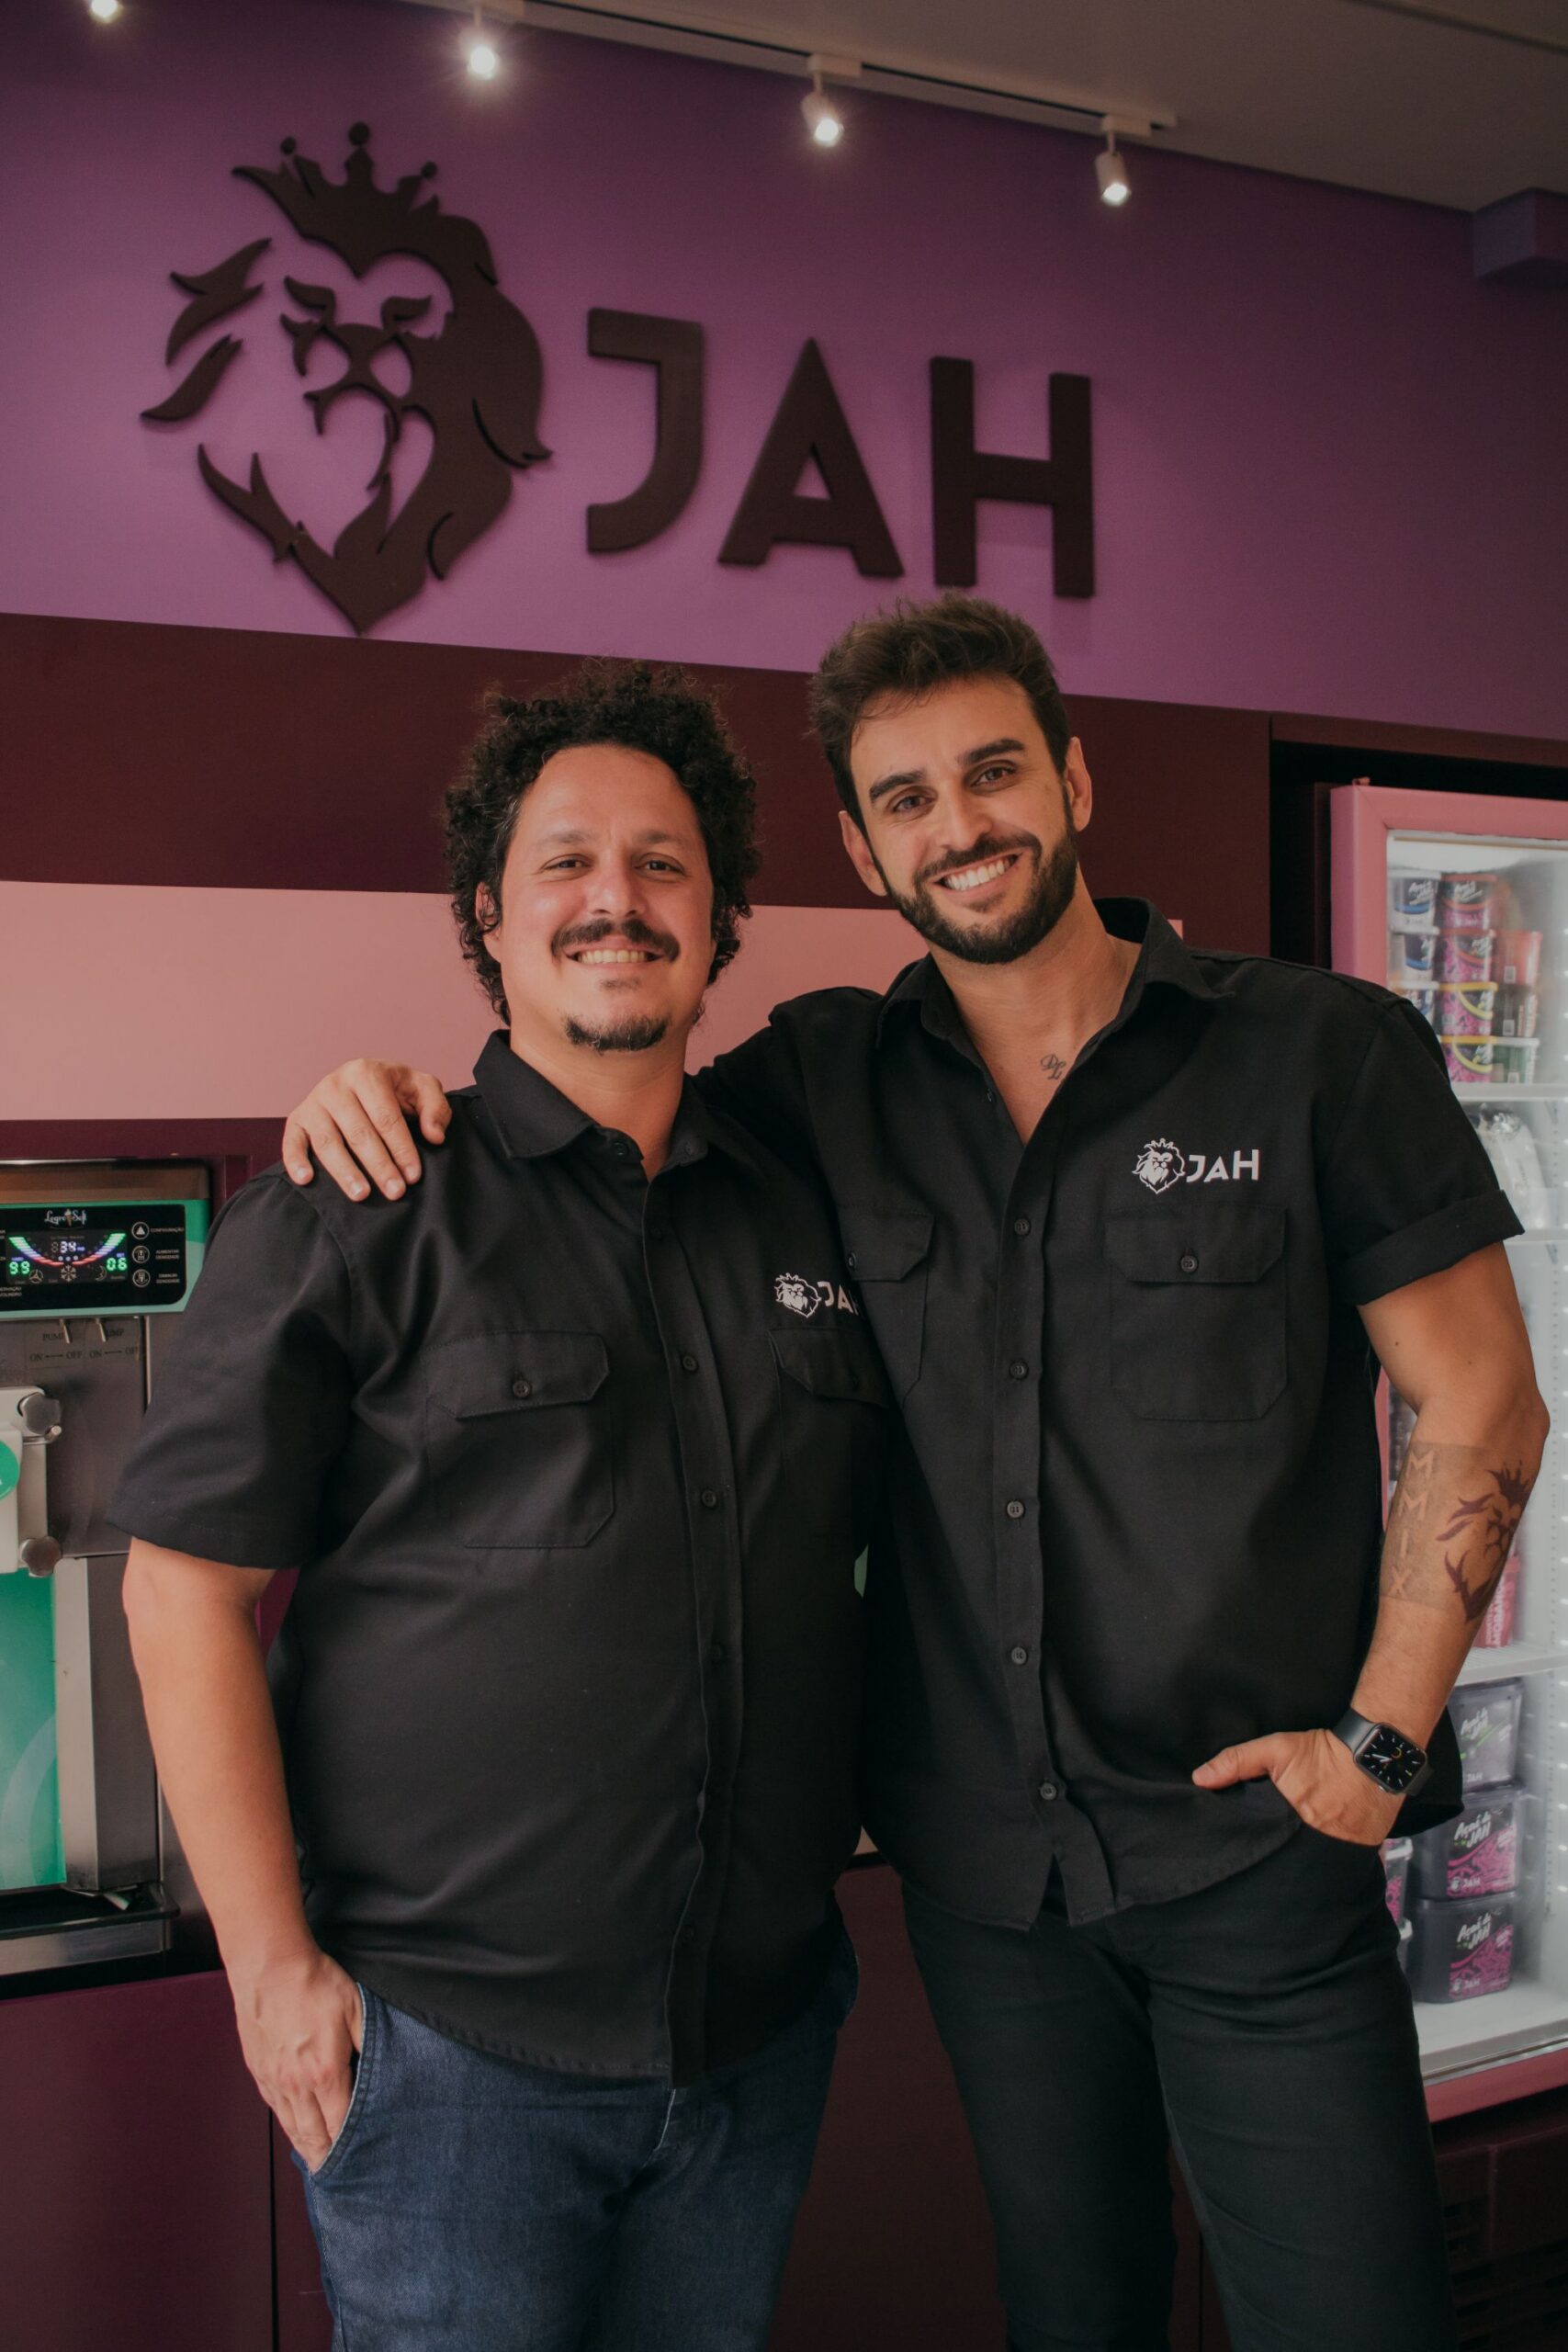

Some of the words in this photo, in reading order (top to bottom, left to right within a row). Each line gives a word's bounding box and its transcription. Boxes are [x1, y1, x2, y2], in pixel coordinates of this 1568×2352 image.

[587, 307, 1096, 599] JAH
[1186, 1148, 1259, 1182] JAH
[817, 1281, 859, 1316] JA
